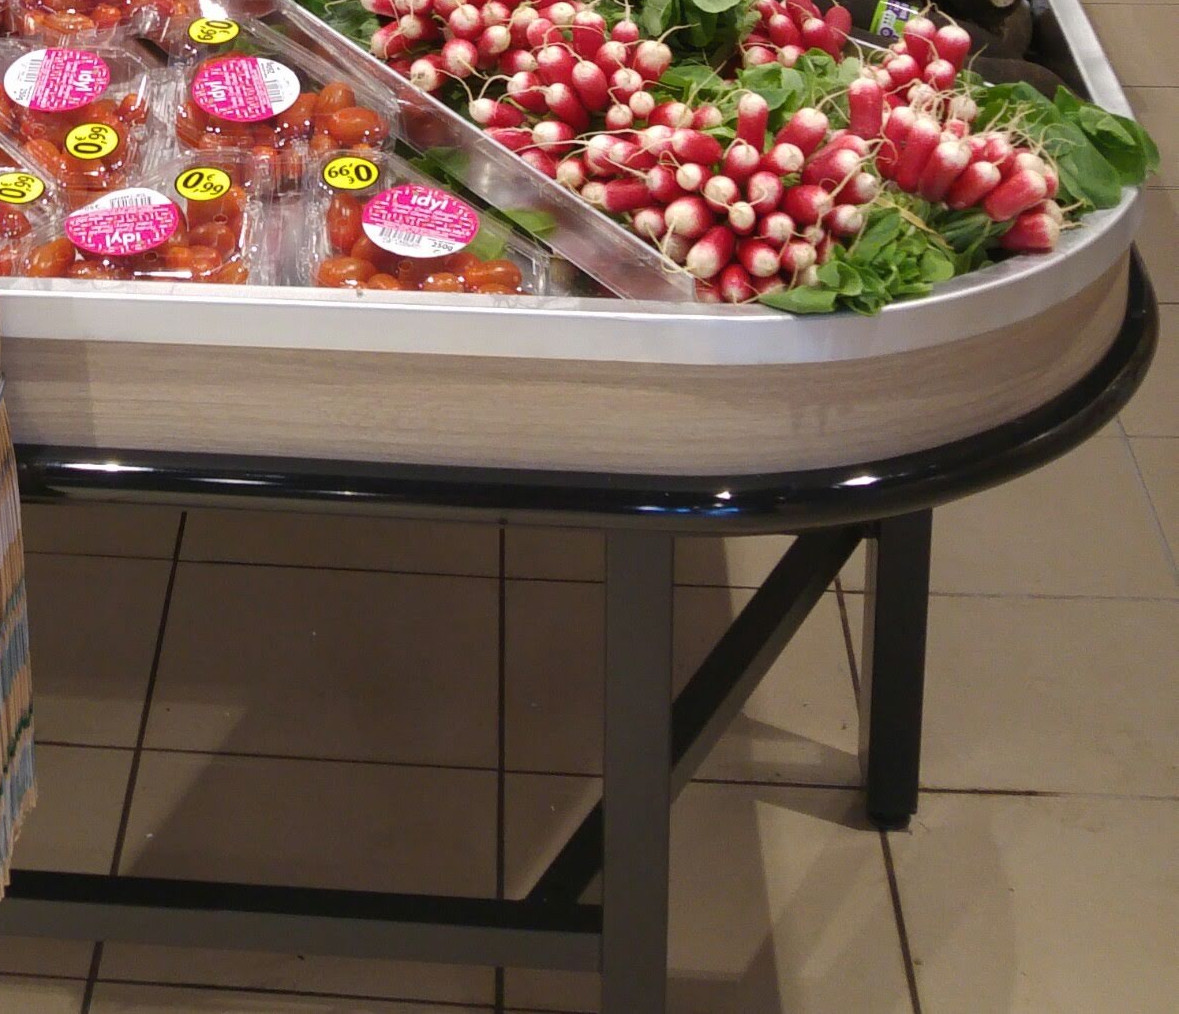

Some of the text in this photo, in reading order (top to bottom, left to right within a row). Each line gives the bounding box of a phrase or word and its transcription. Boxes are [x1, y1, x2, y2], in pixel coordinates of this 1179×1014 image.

[73, 70, 95, 93] idyl
[205, 81, 227, 102] idyl
[411, 193, 448, 210] idyl
[105, 233, 141, 248] idyl
